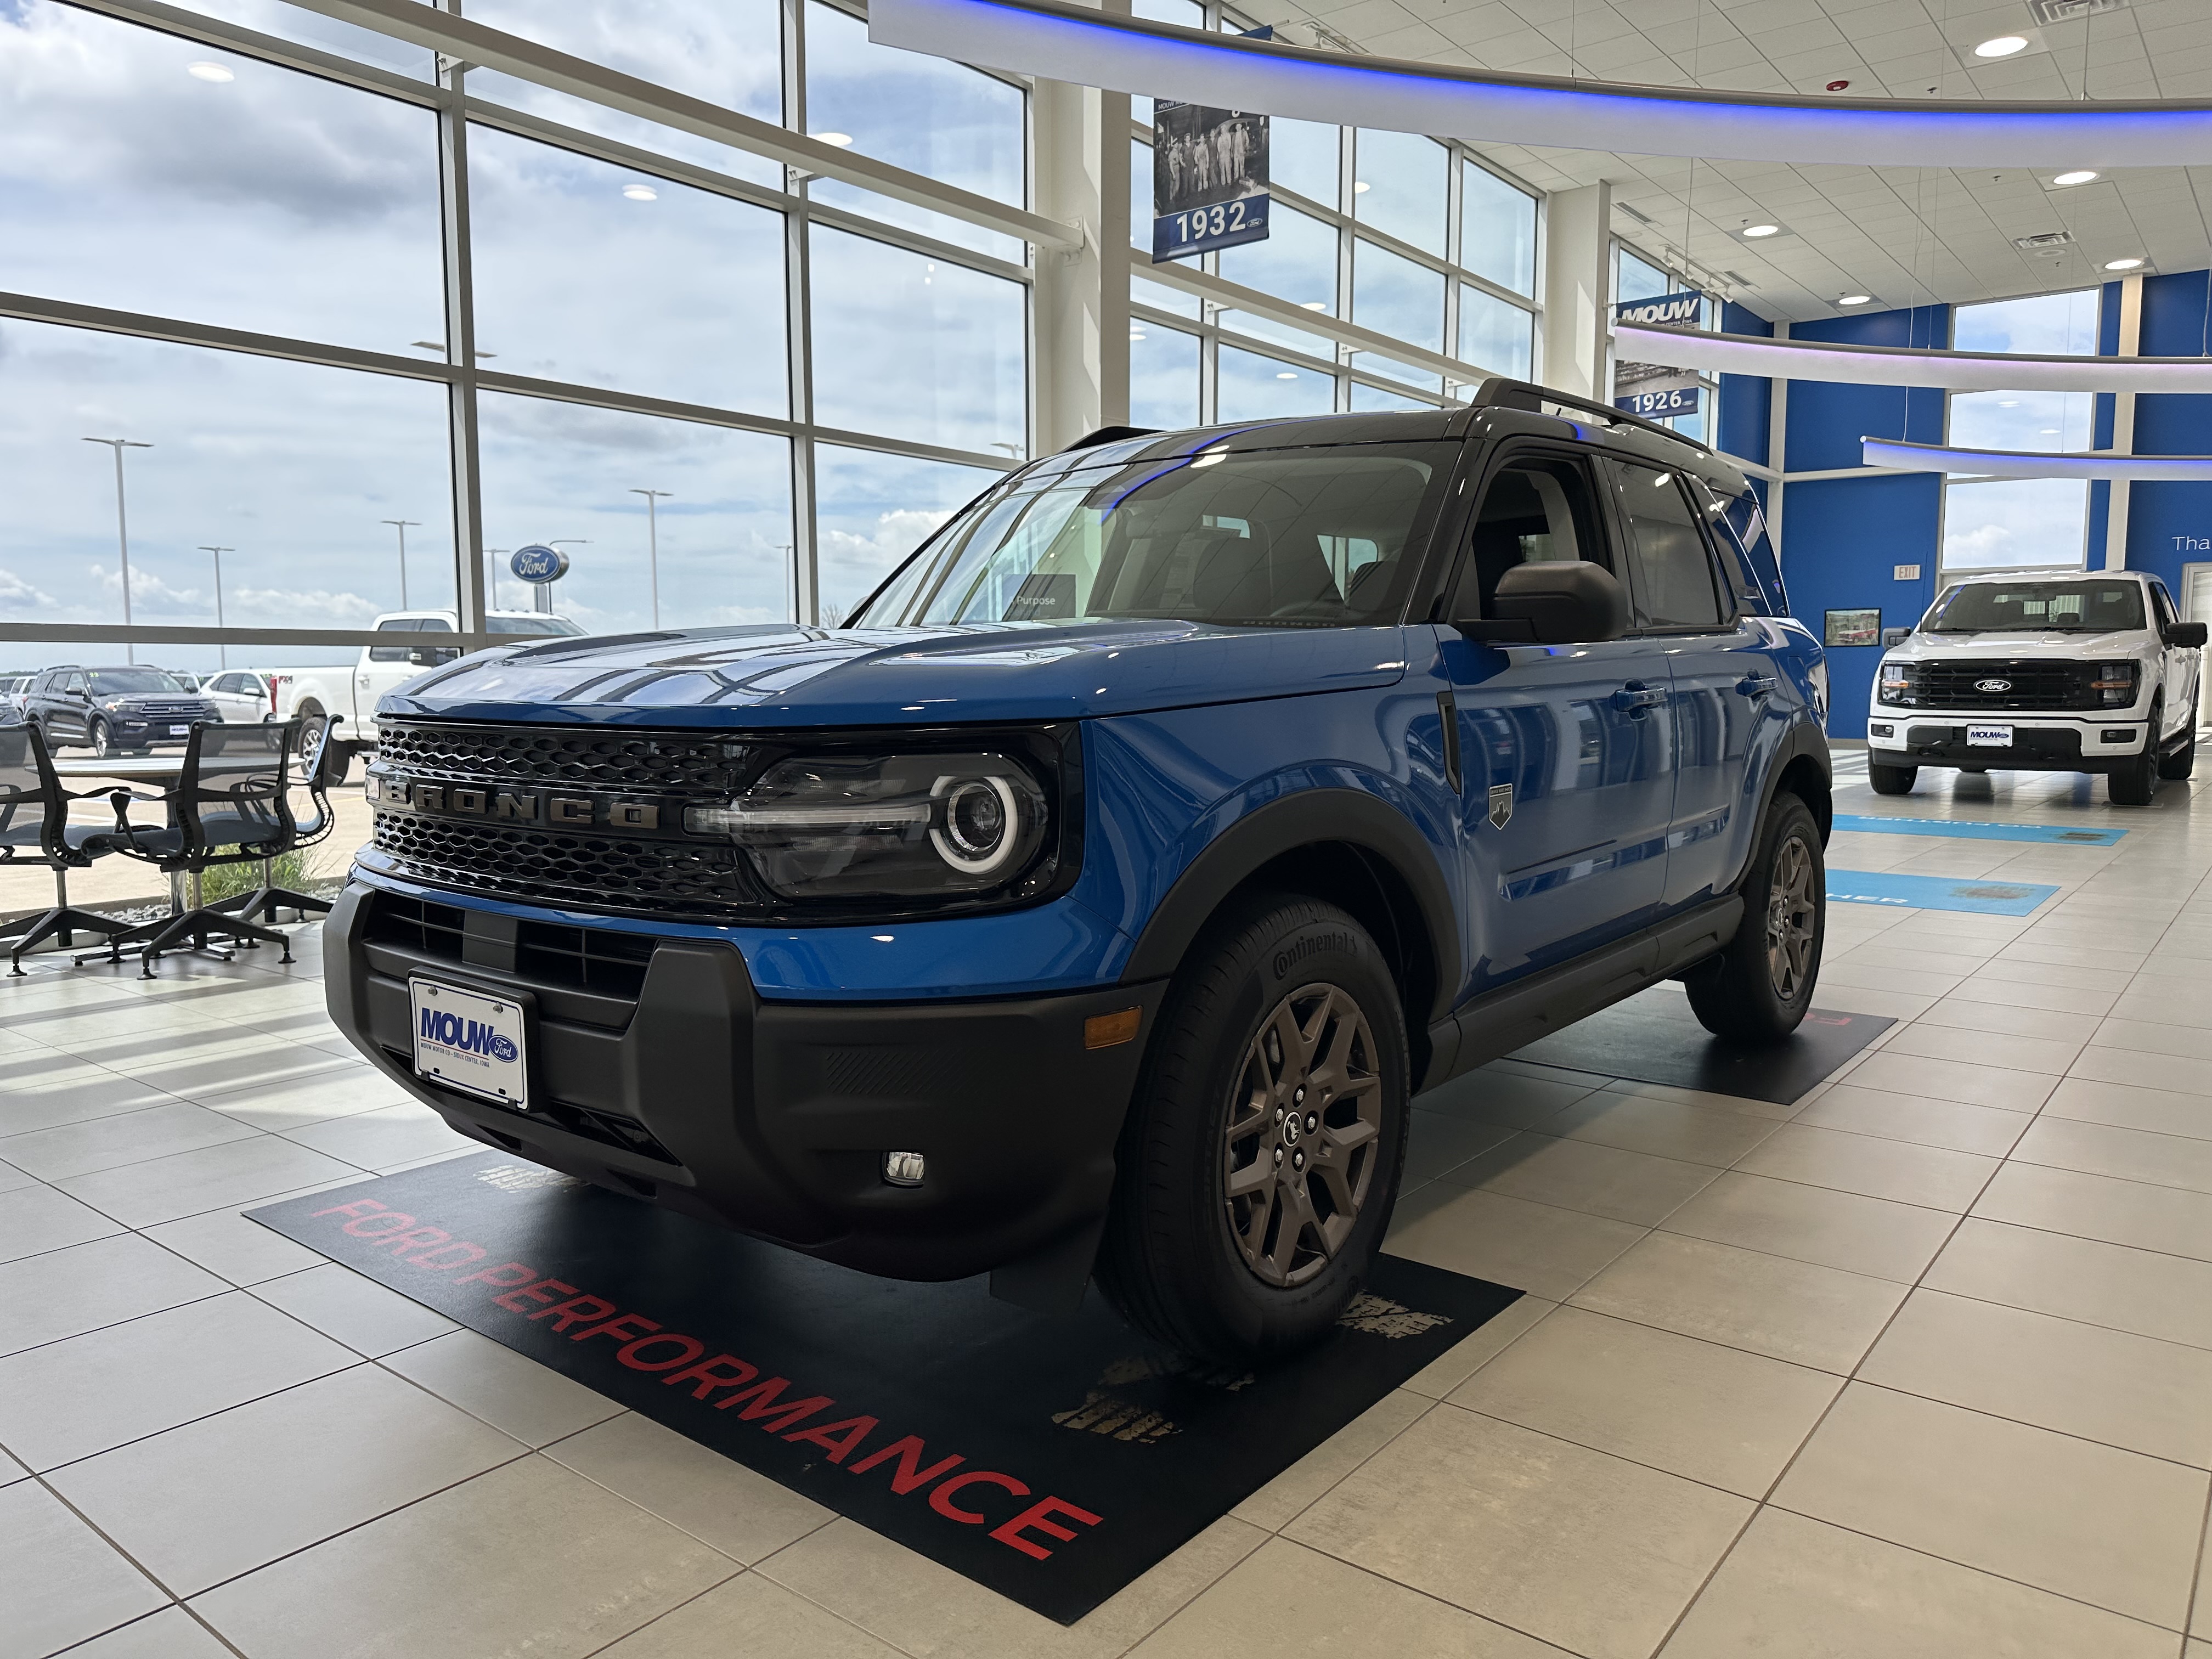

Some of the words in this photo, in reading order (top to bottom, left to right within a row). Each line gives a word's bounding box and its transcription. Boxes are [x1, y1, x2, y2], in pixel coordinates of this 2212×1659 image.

[1177, 201, 1246, 242] 1932
[1622, 298, 1699, 323] MOUW
[1632, 390, 1681, 413] 1926
[2171, 535, 2210, 551] Tha
[519, 552, 549, 575] Ford
[1899, 566, 1916, 578] EXIT
[1017, 596, 1056, 605] Purpose
[386, 780, 660, 829] BRONCO
[1273, 931, 1348, 980] Continental
[421, 1007, 494, 1056] MOUW
[311, 1198, 488, 1271] FORD
[453, 1262, 1104, 1561] PERFORMANCE
